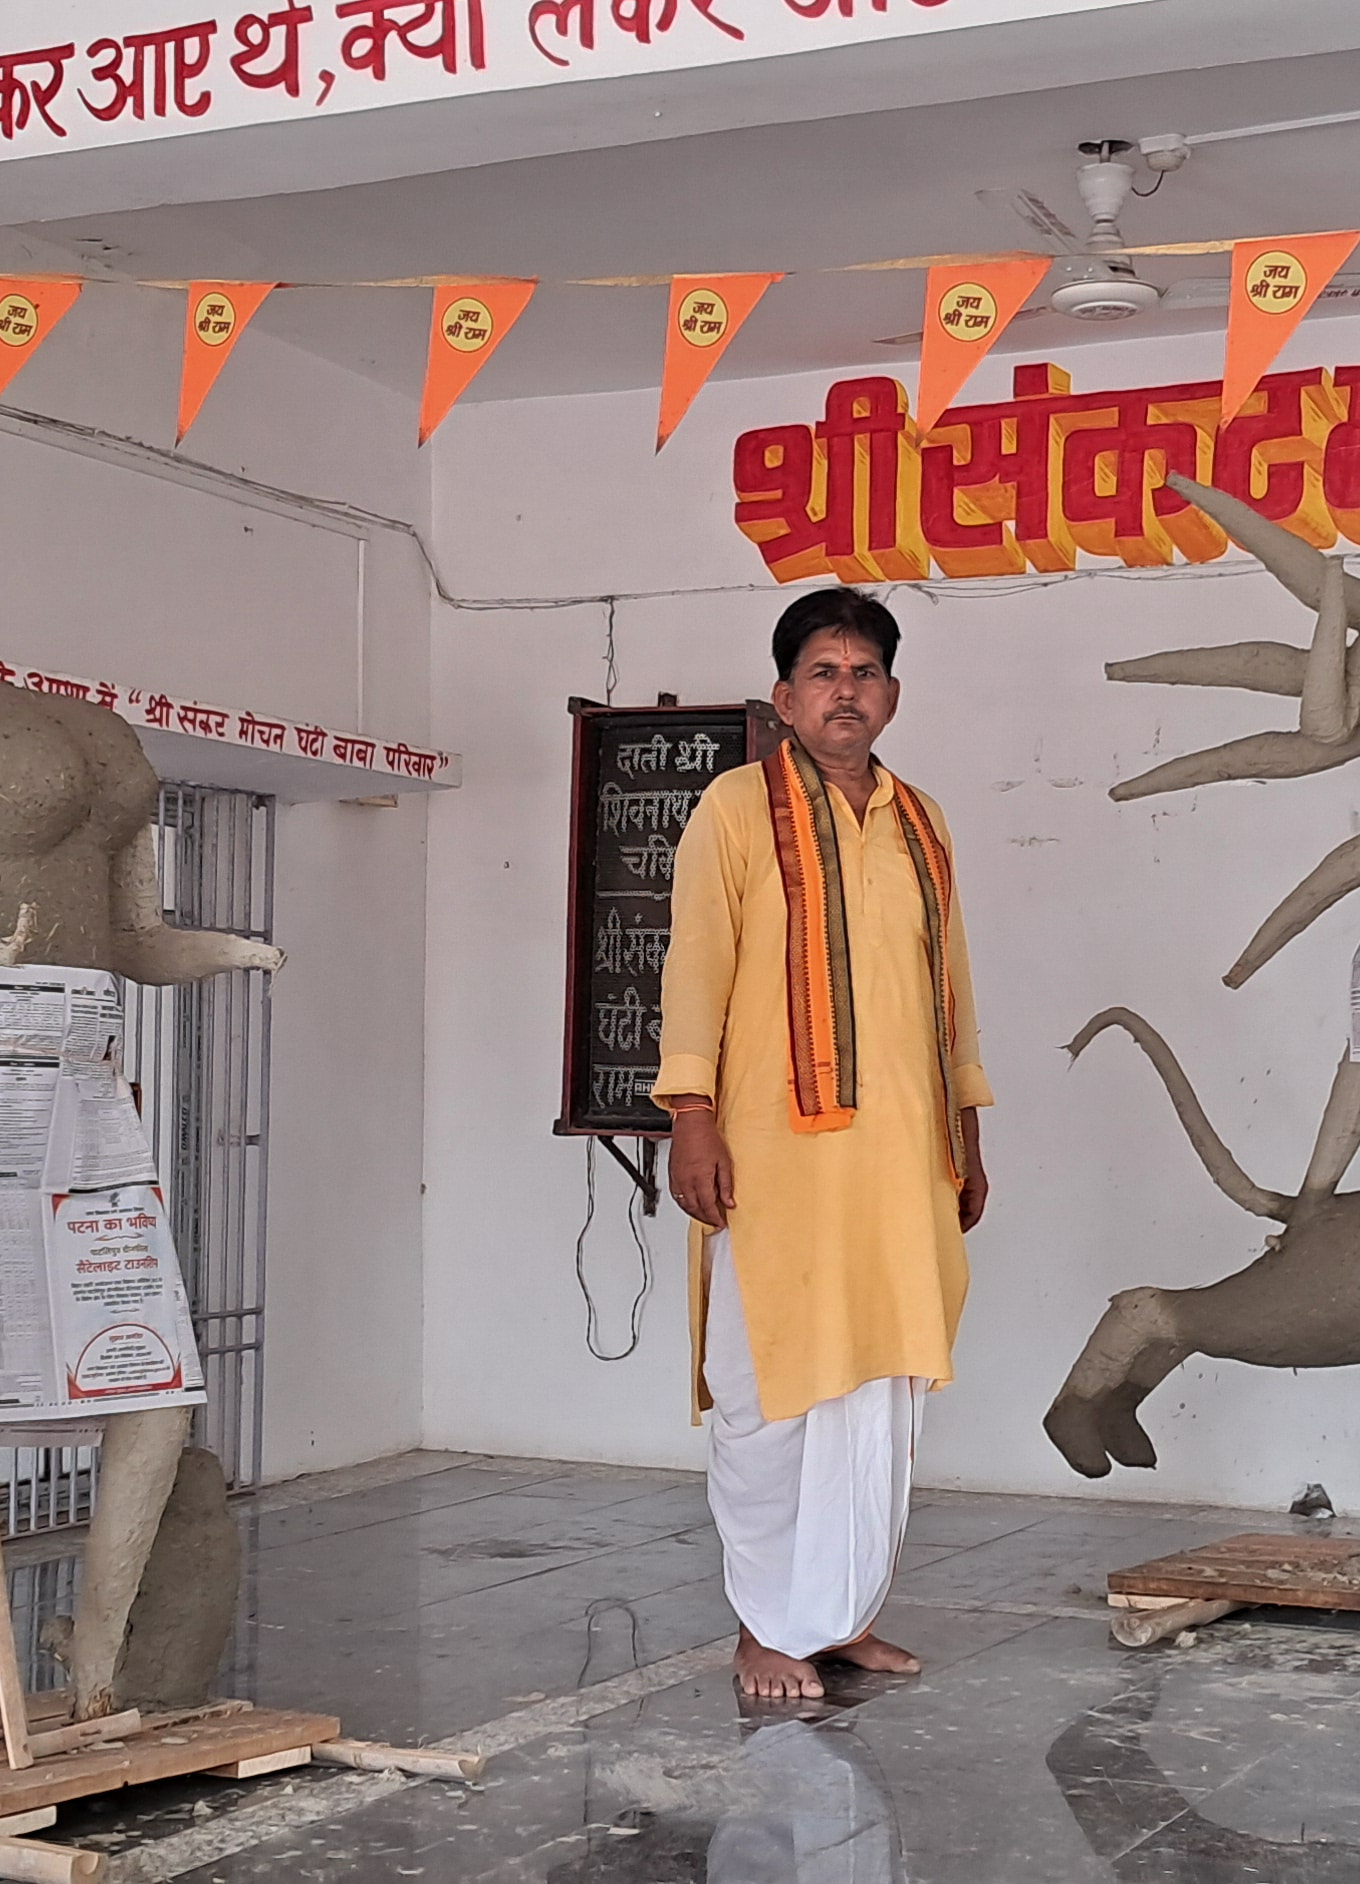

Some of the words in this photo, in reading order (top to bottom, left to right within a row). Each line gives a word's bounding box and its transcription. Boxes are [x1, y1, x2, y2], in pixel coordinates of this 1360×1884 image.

[77, 20, 217, 121] आए
[1264, 265, 1290, 279] जय
[1250, 280, 1270, 298] श्री
[1273, 285, 1300, 299] राम
[207, 304, 225, 316] जय
[693, 302, 715, 315] जय
[956, 295, 982, 310] जय
[8, 305, 27, 318] जय
[458, 309, 480, 323] जय
[943, 308, 962, 326] श्री
[965, 315, 990, 328] राम
[12, 323, 32, 336] राम
[198, 317, 210, 332] श्री
[212, 321, 231, 334] राम
[446, 322, 462, 337] श्री
[465, 327, 487, 341] राम
[682, 318, 697, 332] श्री
[700, 321, 723, 334] राम
[177, 699, 230, 737] संकट
[238, 710, 286, 752] मोचन
[293, 722, 328, 757] घंटी
[332, 735, 377, 770] बाबा
[675, 732, 721, 773] श्री
[67, 1219, 100, 1234] पटना
[104, 1218, 123, 1231] का
